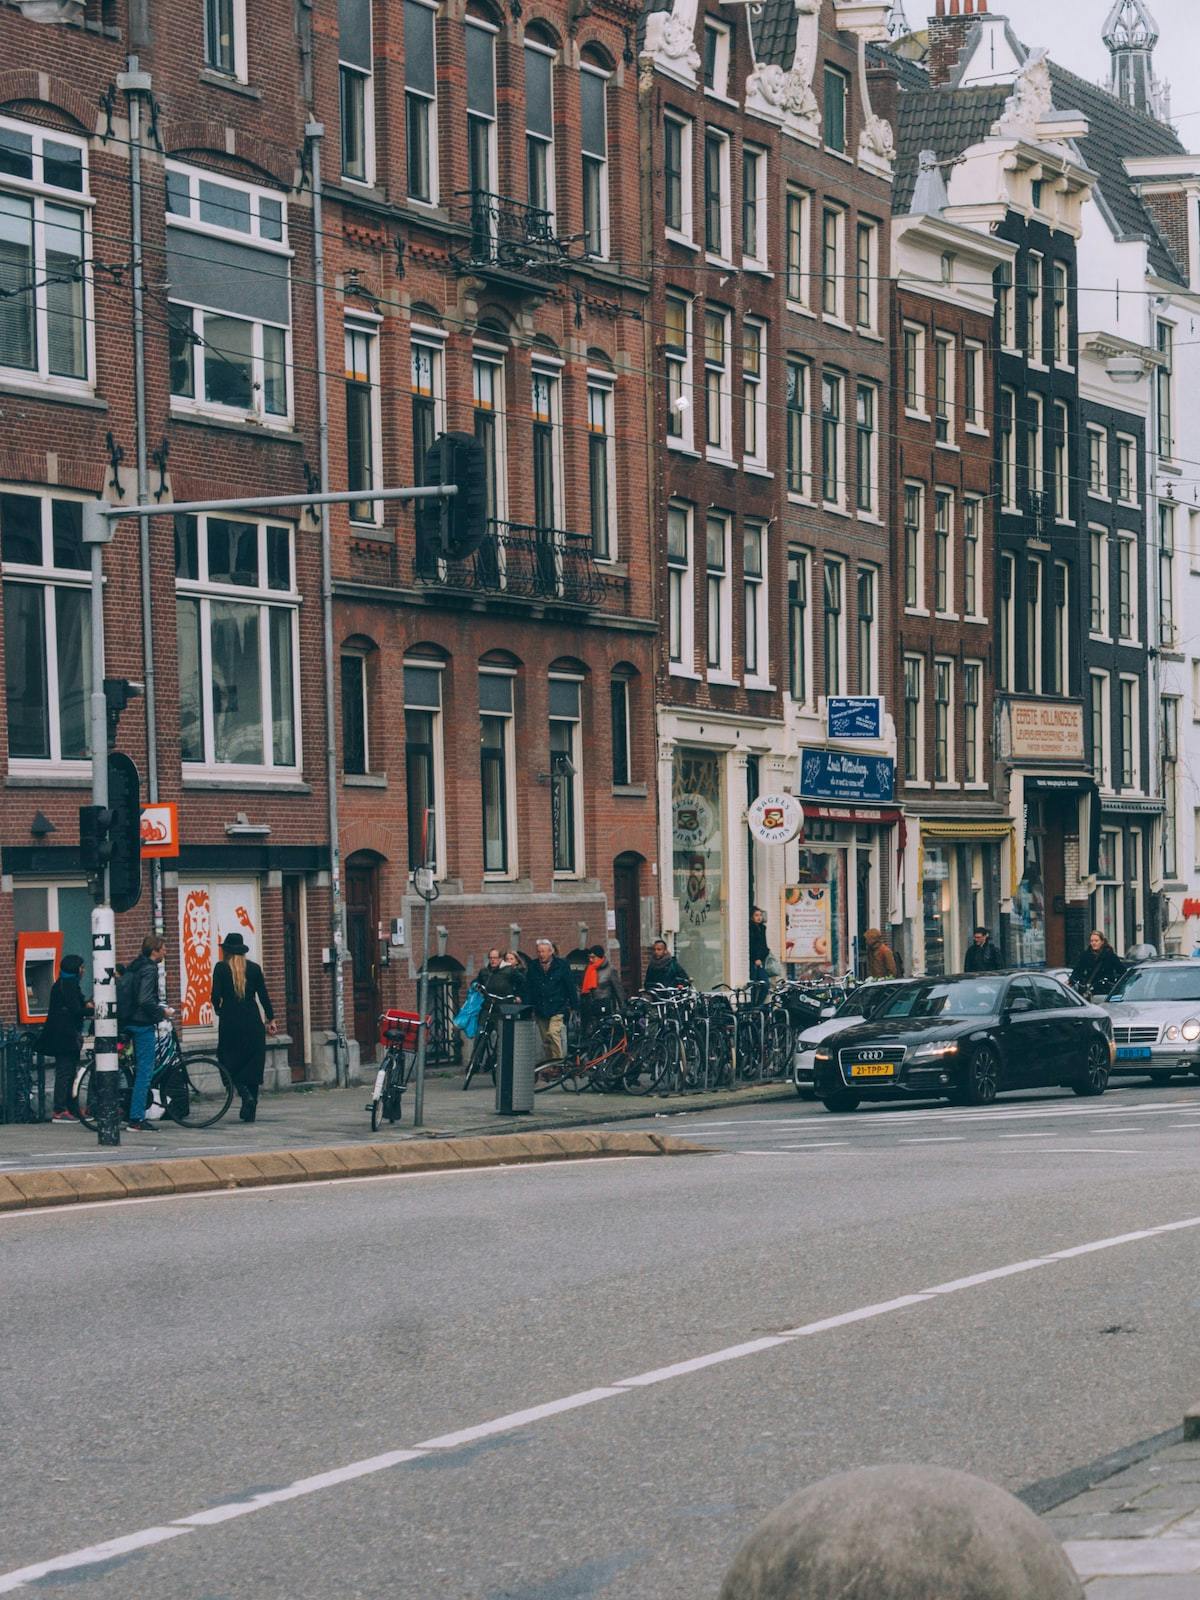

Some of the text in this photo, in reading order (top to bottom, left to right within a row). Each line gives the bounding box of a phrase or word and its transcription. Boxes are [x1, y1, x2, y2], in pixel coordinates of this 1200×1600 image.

[757, 797, 790, 811] BAGELS
[760, 827, 790, 840] BEANS
[856, 1065, 889, 1075] 21-TPP-7
